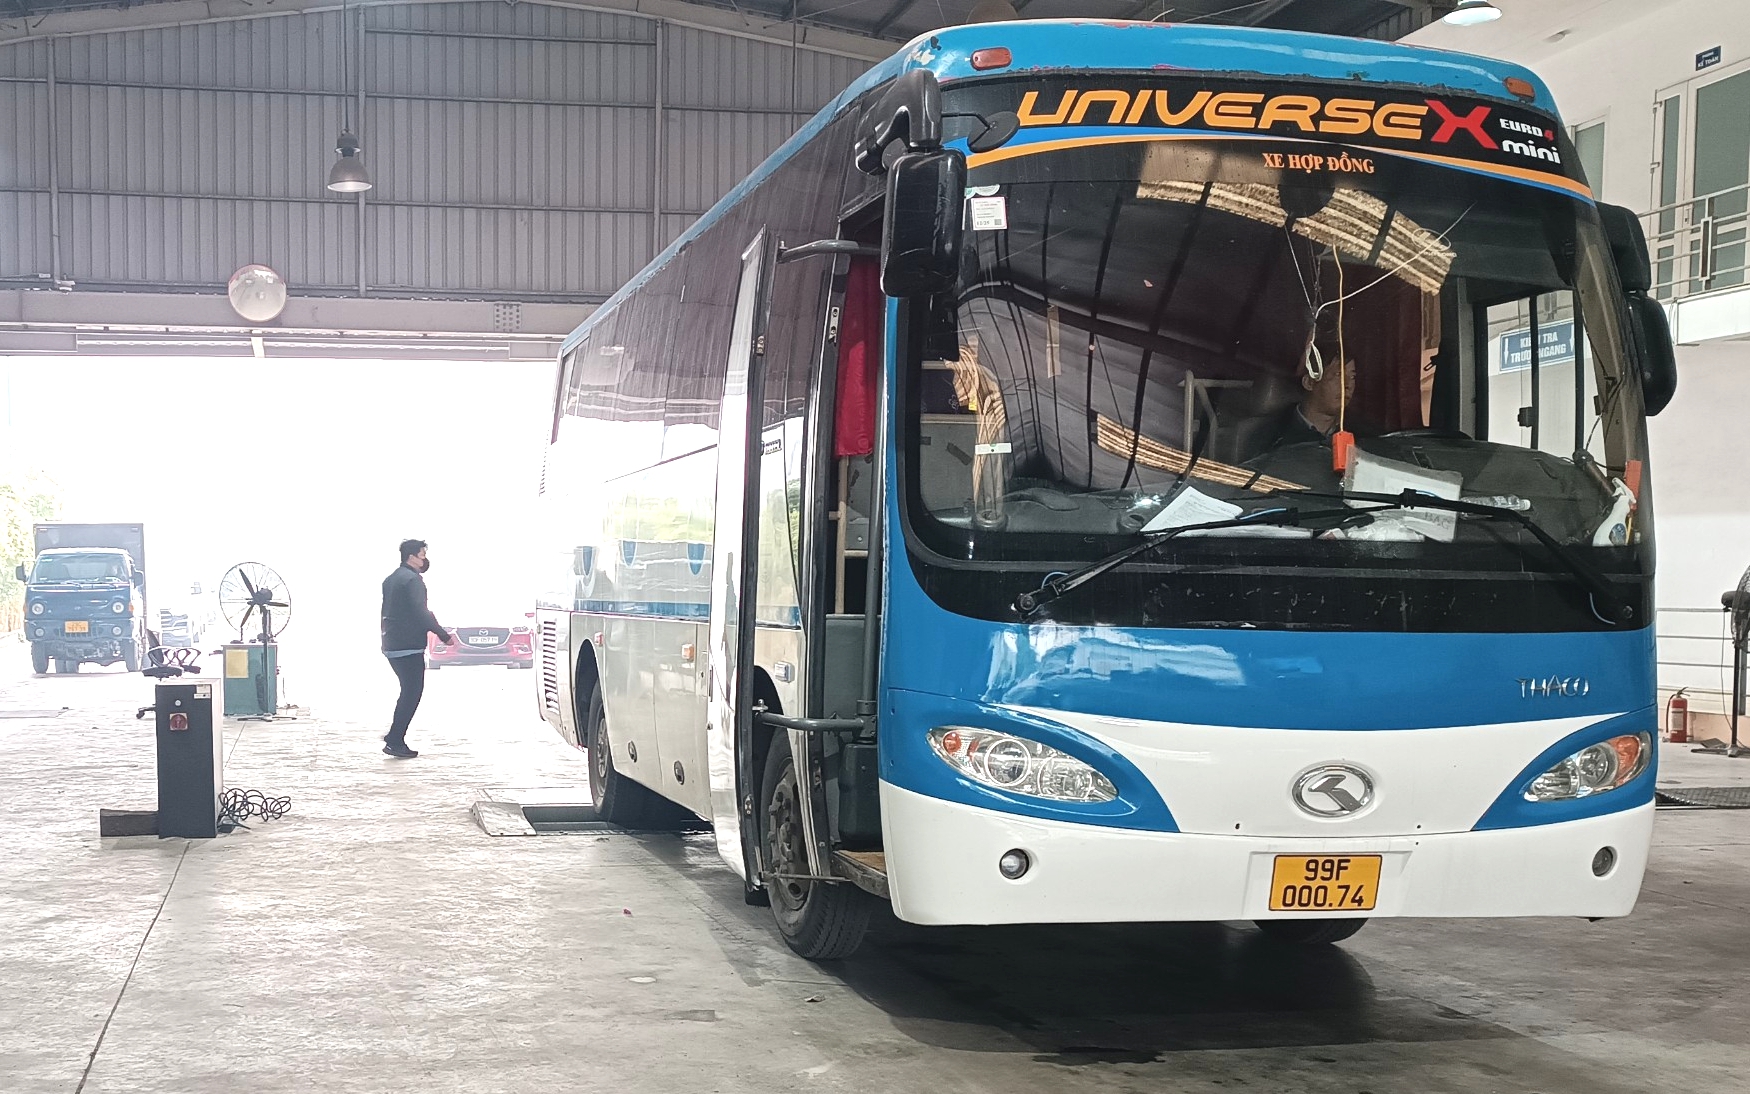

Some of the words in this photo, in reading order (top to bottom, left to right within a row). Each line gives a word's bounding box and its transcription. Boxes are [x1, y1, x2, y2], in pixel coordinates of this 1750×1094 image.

[1262, 153, 1285, 168] XE
[1288, 153, 1323, 174] HỢP
[1326, 151, 1375, 174] ĐỒNG
[1502, 139, 1561, 165] mini
[1543, 332, 1558, 343] TRA
[1516, 674, 1589, 698] THACO
[1304, 859, 1351, 881] 99F
[1281, 885, 1364, 907] 000.74
